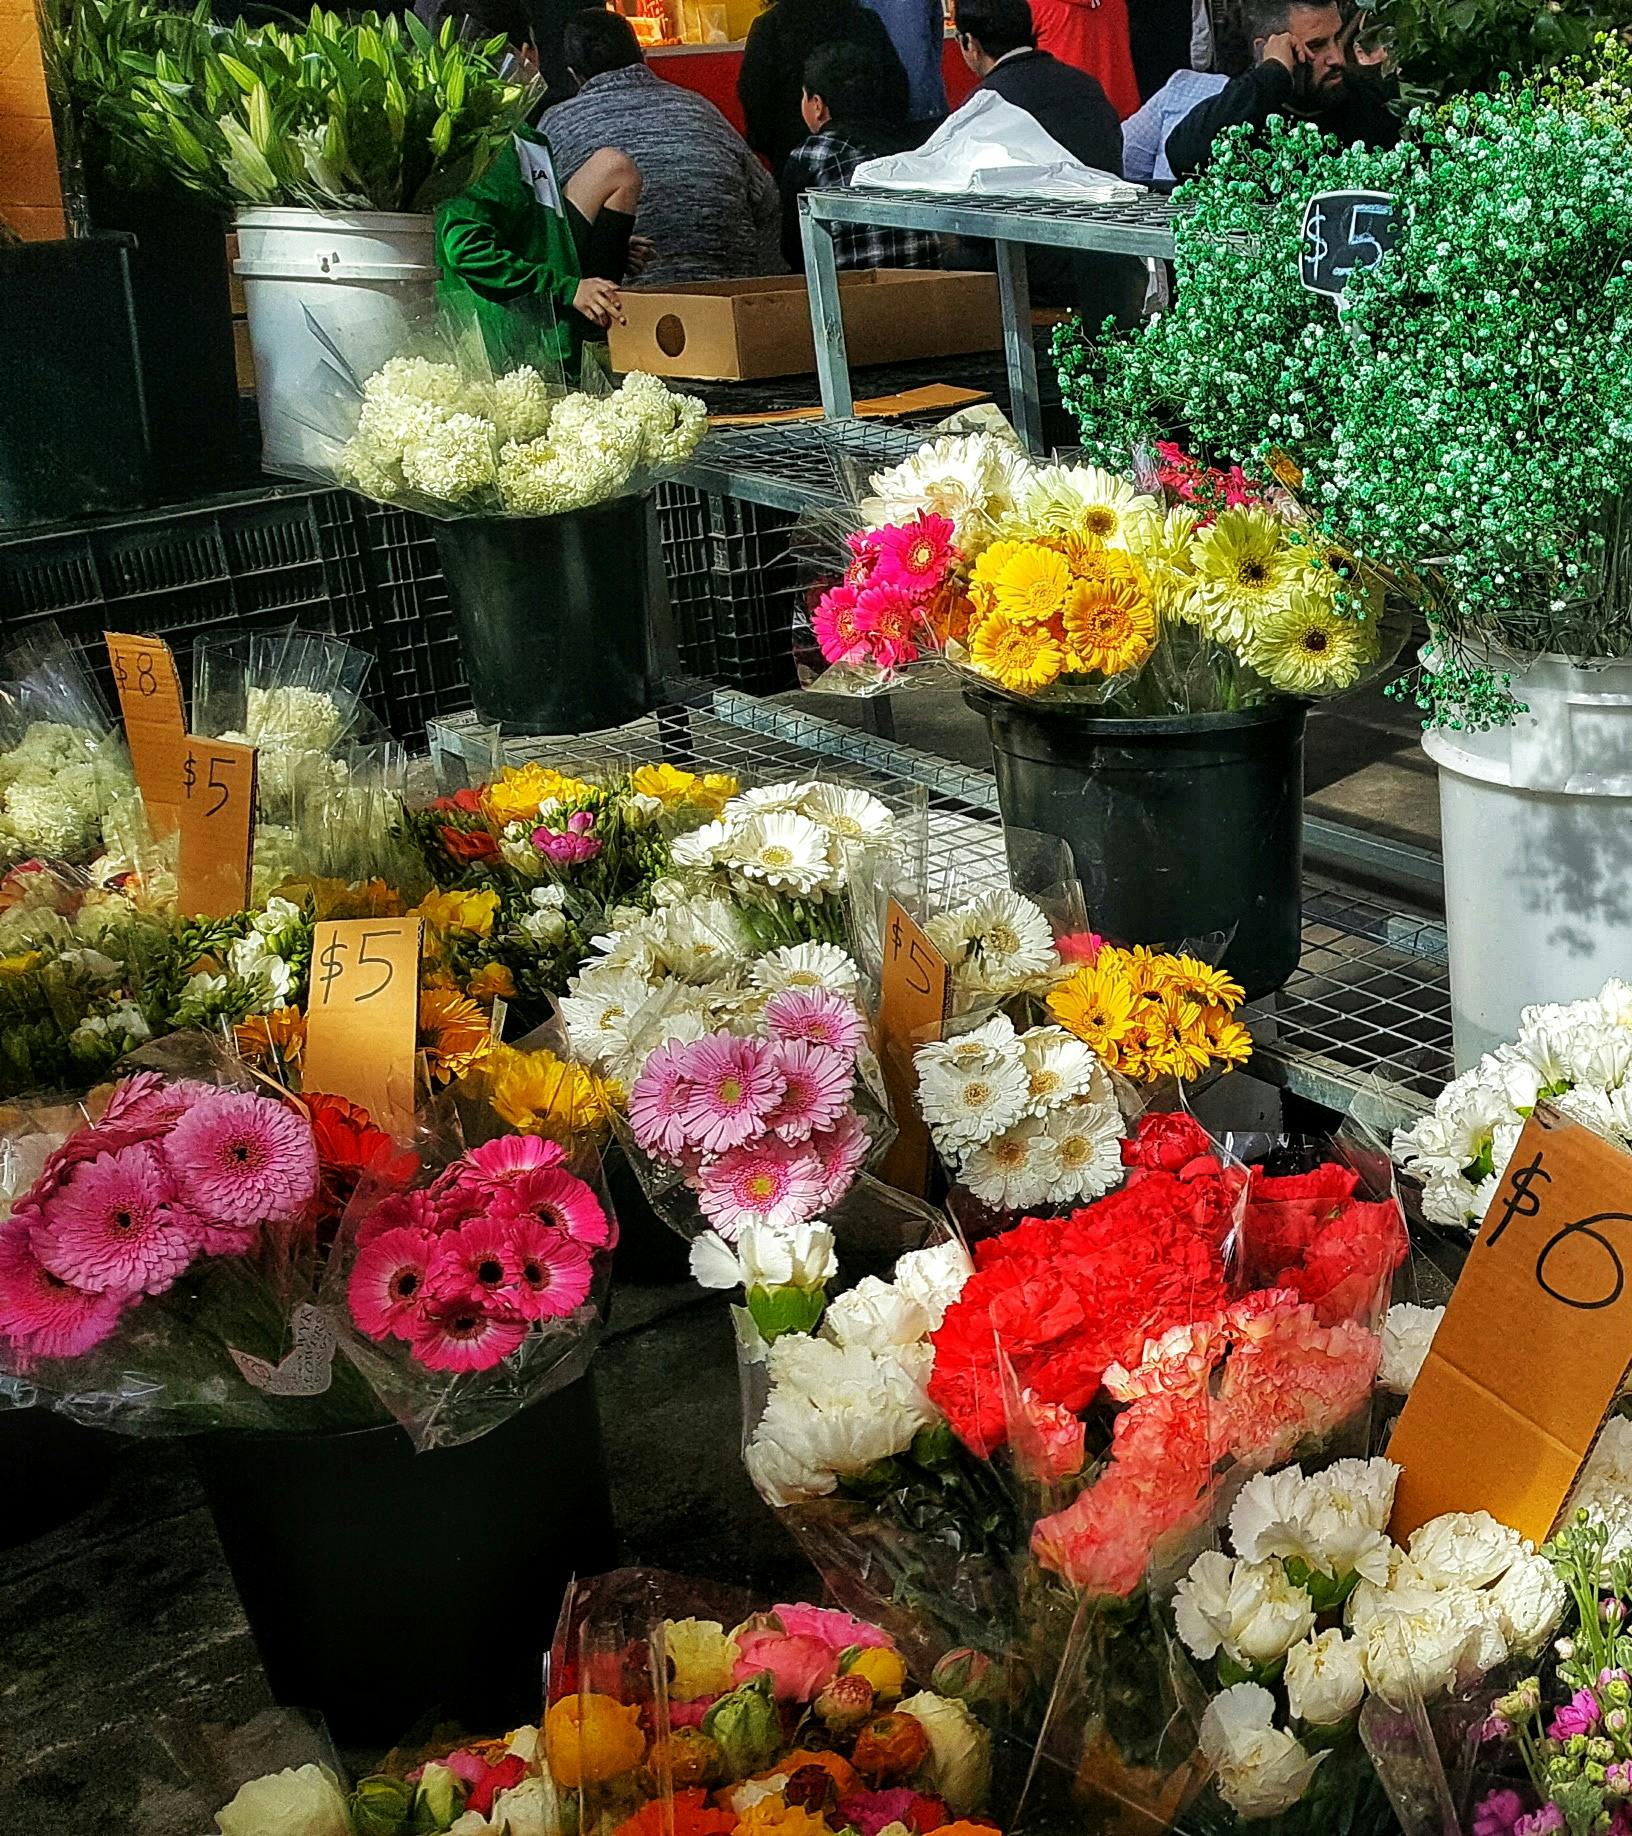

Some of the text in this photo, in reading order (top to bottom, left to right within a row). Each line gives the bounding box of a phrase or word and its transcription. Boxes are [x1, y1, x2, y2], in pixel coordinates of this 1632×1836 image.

[1304, 203, 1393, 280] $5
[114, 648, 157, 696] $8
[182, 750, 236, 817] $5
[320, 929, 402, 1004] $5
[891, 916, 935, 994] $5
